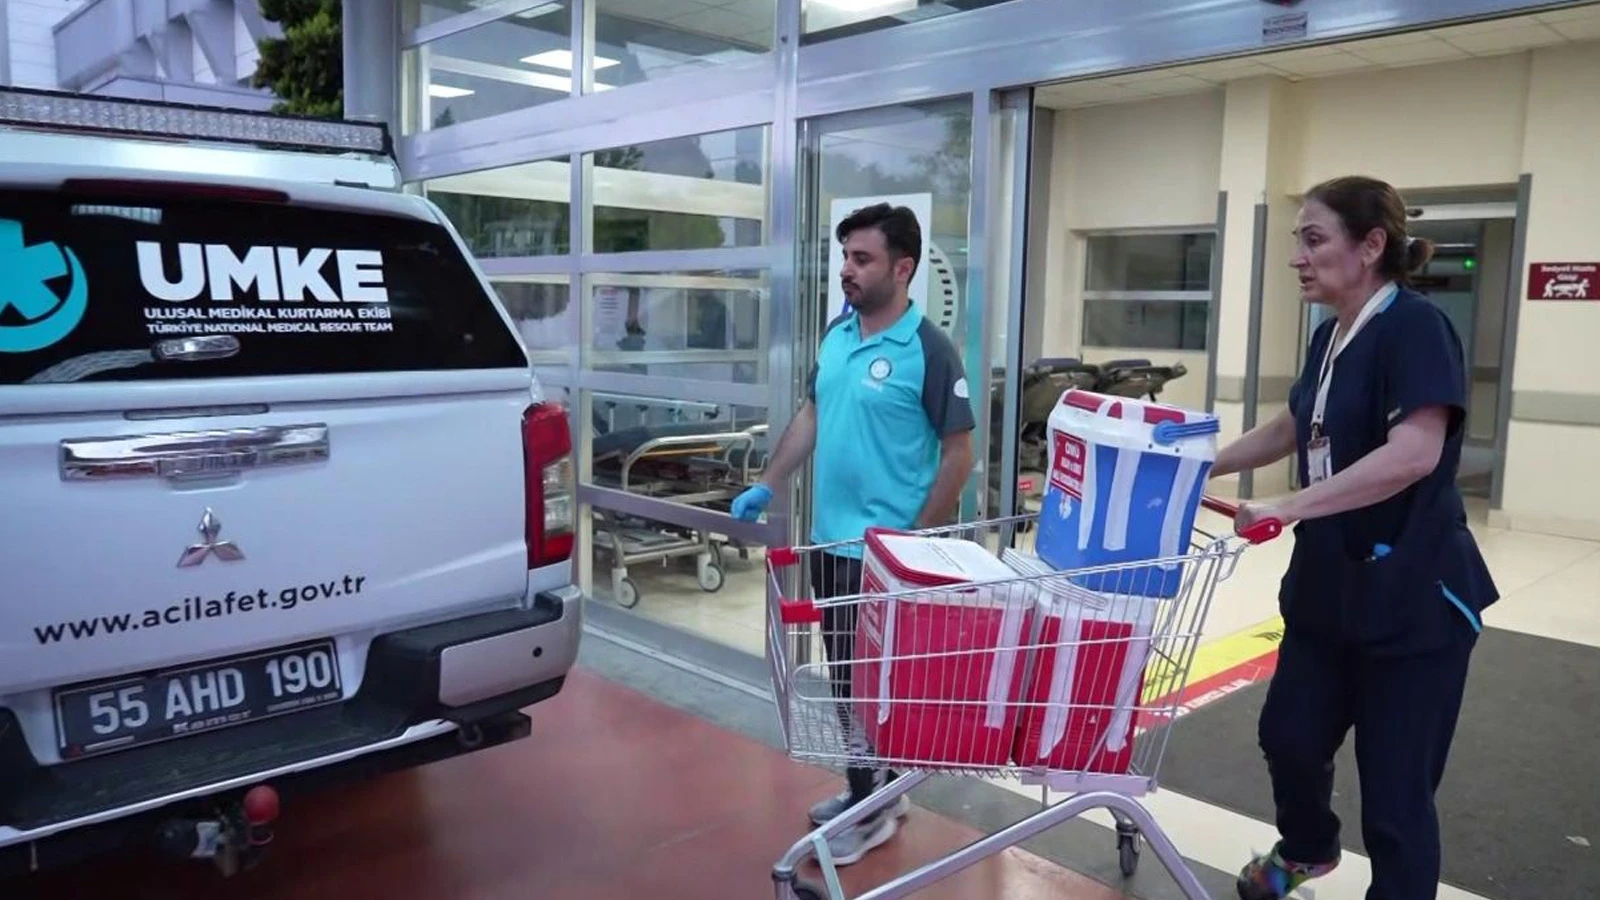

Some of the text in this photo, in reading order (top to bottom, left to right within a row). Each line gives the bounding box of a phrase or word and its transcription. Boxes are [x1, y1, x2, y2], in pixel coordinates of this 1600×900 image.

[136, 241, 388, 302] UMKE
[144, 305, 391, 319] ULUSAL MEDİKAL KURTARMA EKİBİ
[146, 320, 393, 334] TÜRKİYE NATIONAL MEDICAL RESCUE TEAM
[34, 575, 365, 645] www.acilafet.gov.tr
[89, 685, 149, 734] 55
[165, 667, 246, 720] AHD
[265, 651, 332, 697] 190
